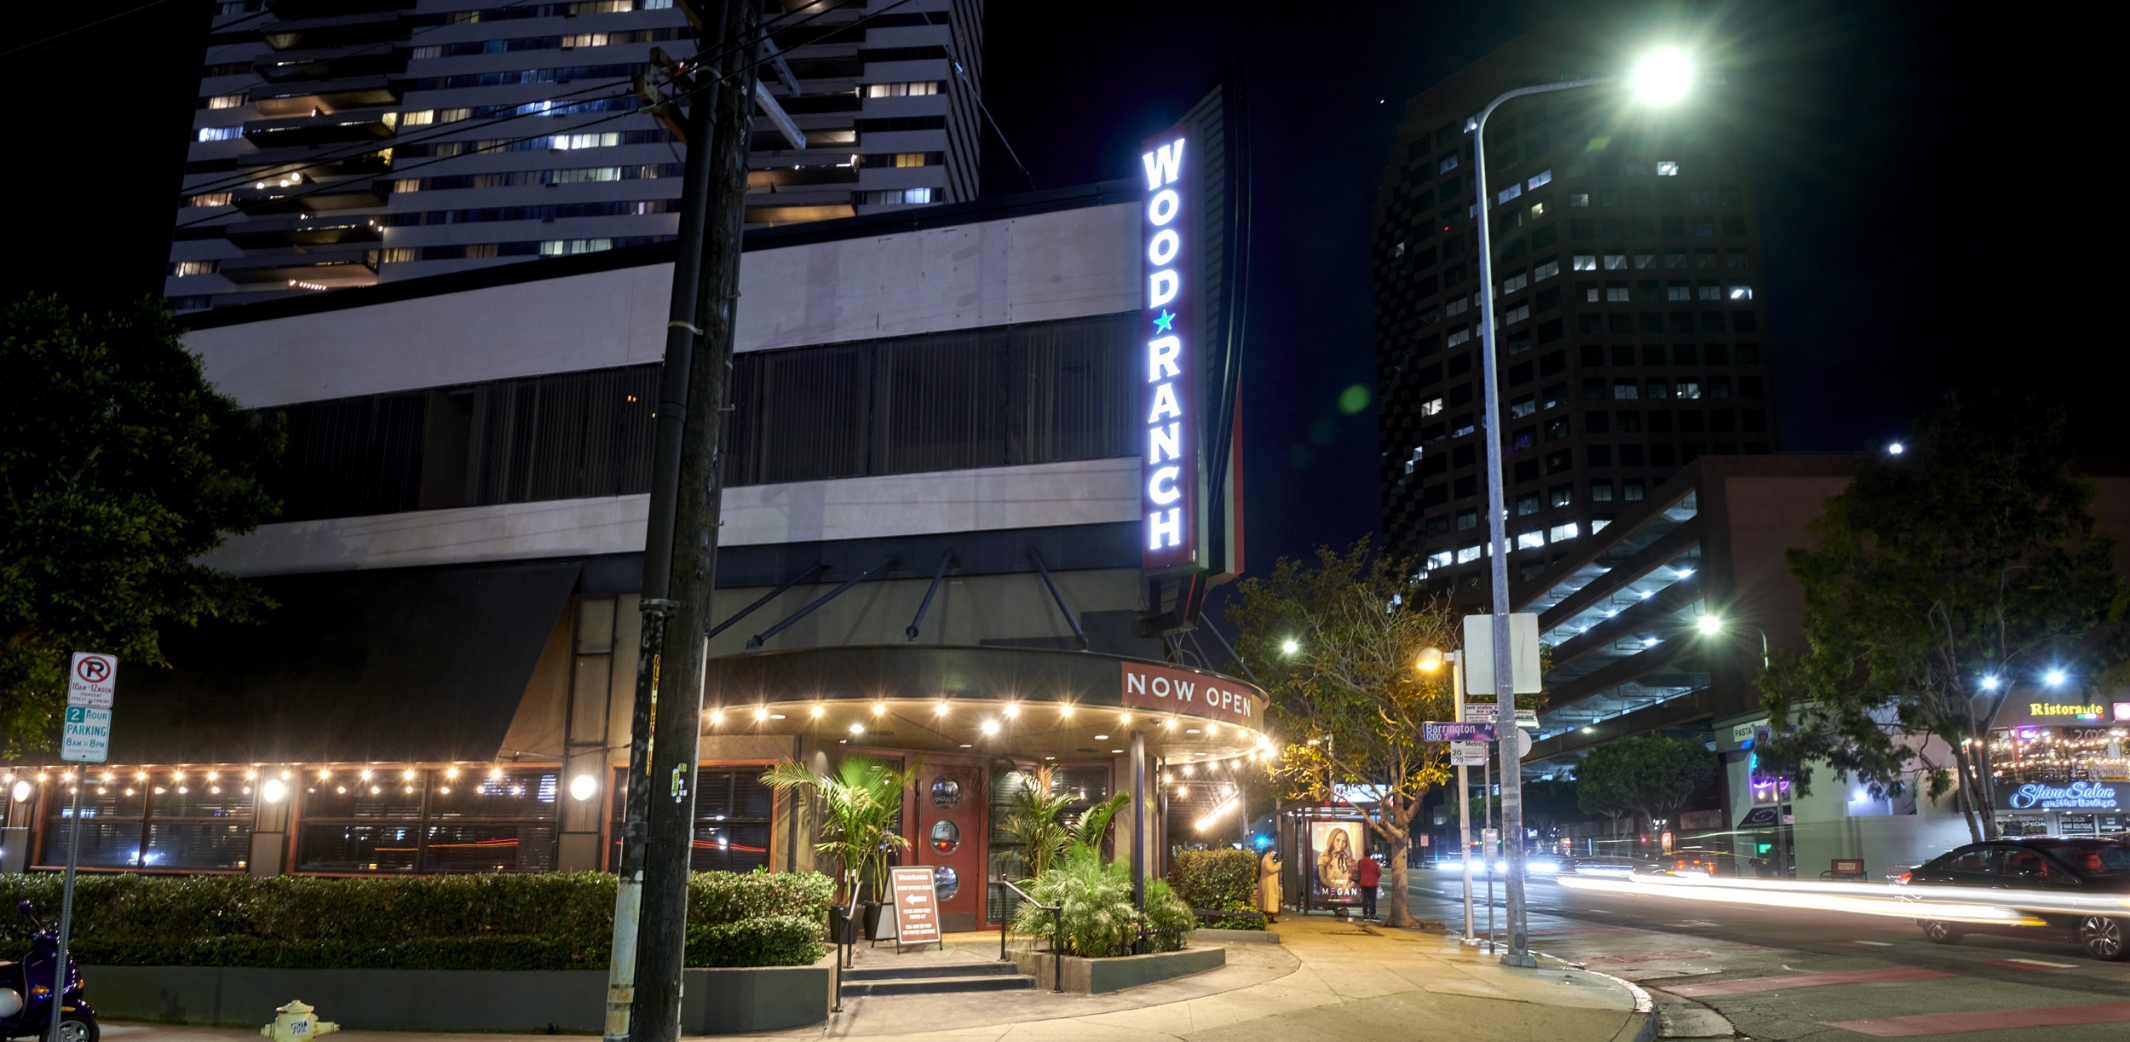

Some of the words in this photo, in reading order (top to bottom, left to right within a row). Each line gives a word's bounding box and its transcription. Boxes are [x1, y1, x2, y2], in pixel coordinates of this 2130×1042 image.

[1142, 137, 1185, 310] WOOD
[1147, 333, 1181, 551] RANCH
[72, 682, 86, 690] 10AM
[1127, 672, 1195, 701] NOW
[1206, 687, 1251, 717] OPEN
[71, 709, 80, 720] 2
[86, 711, 107, 720] HOUR
[2030, 703, 2103, 715] Ristorante
[67, 724, 107, 736] PARKING
[1426, 724, 1476, 736] Barrington
[1735, 727, 1752, 738] PASTA
[66, 738, 81, 746] 8AM
[90, 739, 105, 748] 8PM
[2010, 783, 2066, 808] Shiva
[2067, 782, 2115, 799] Salon
